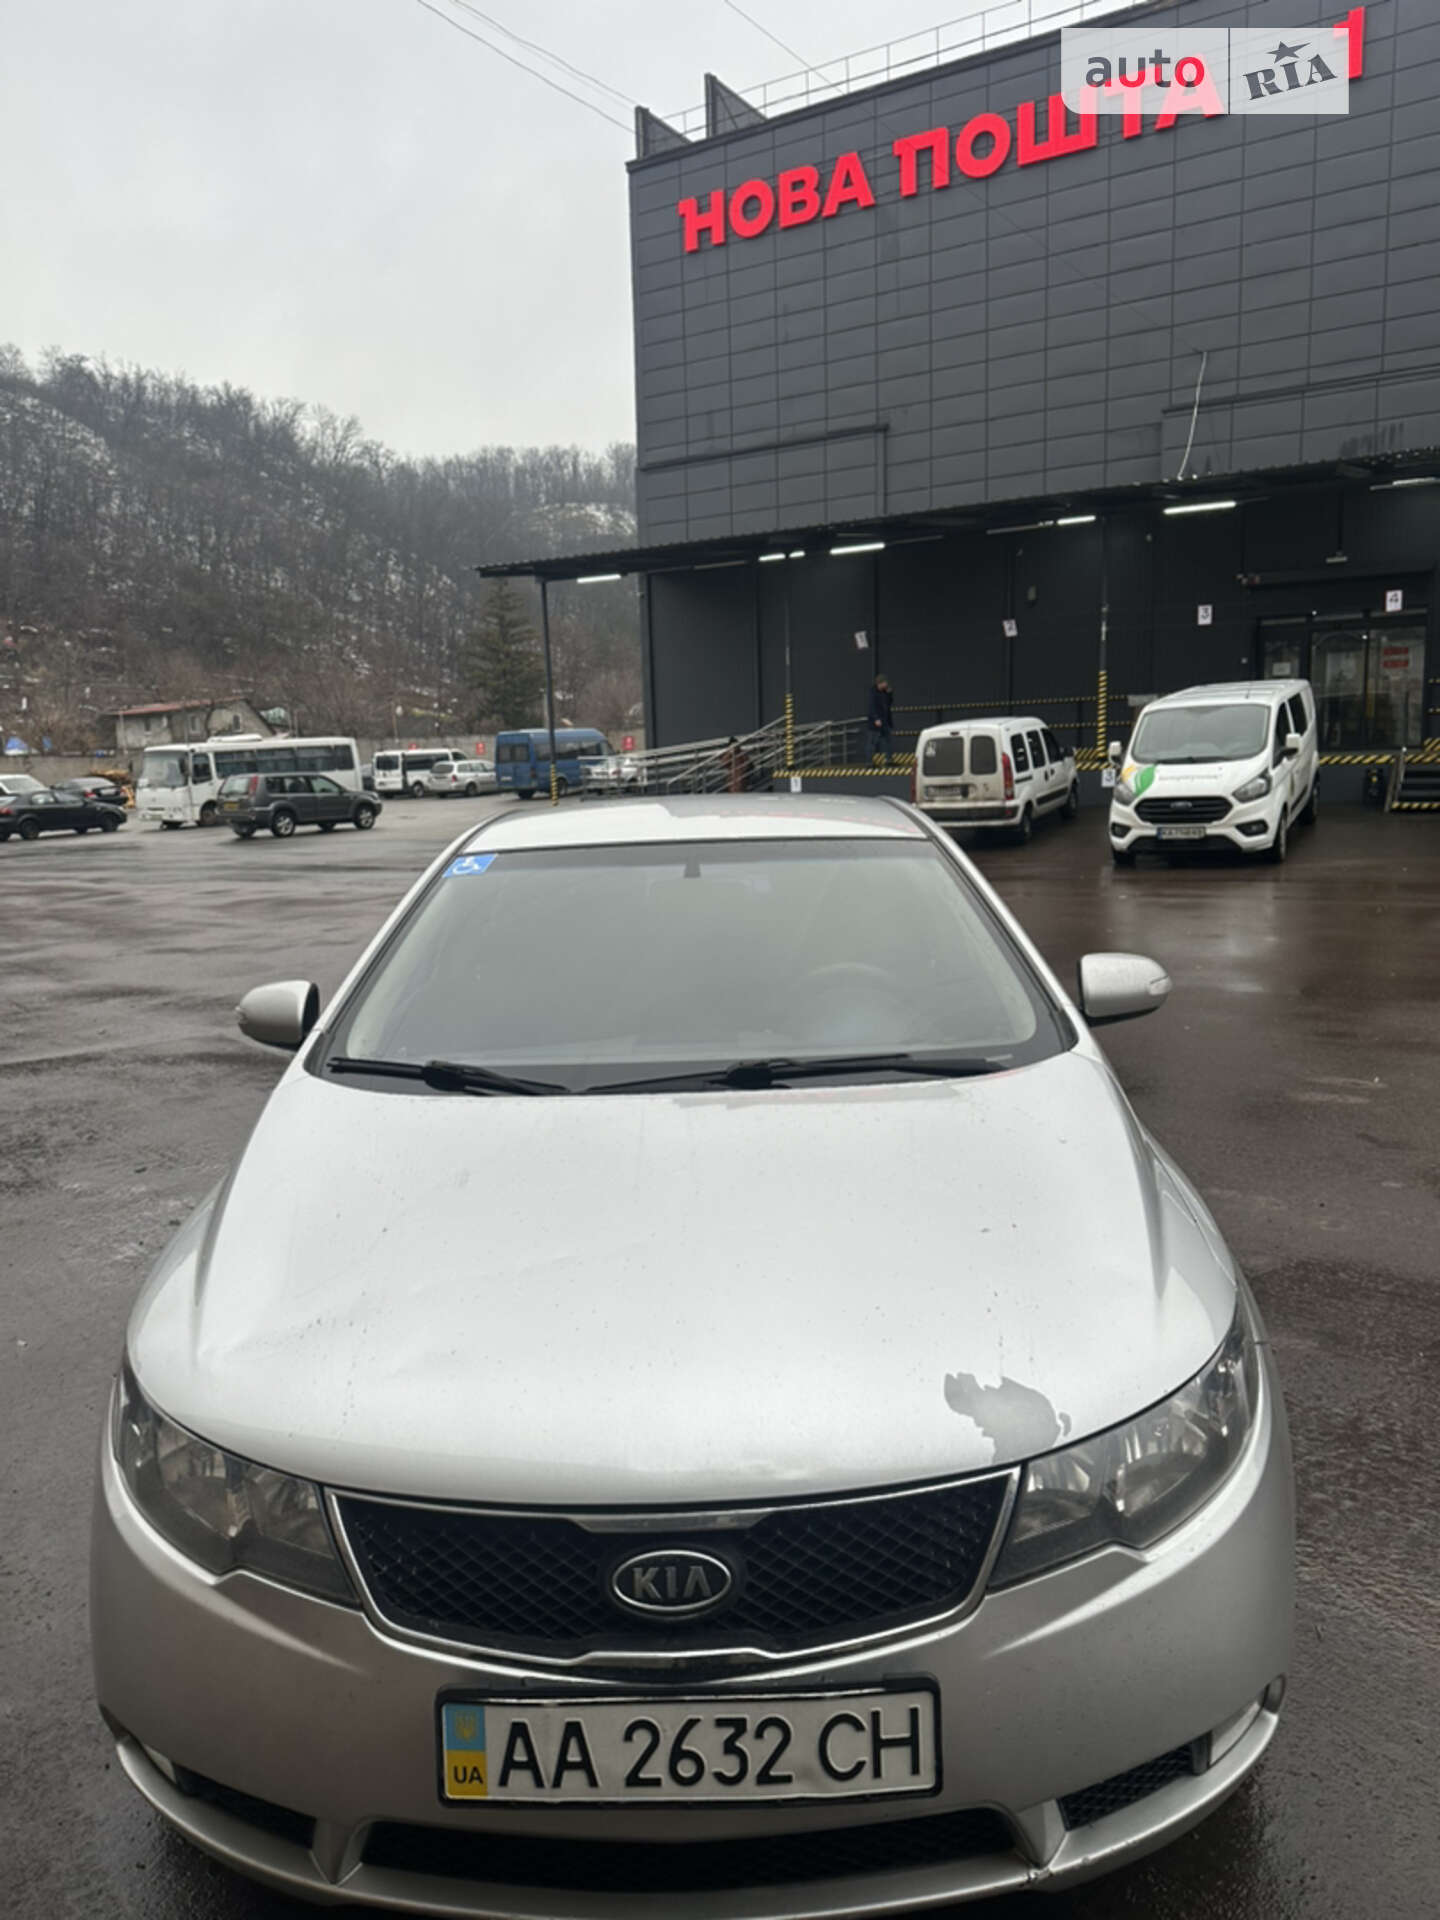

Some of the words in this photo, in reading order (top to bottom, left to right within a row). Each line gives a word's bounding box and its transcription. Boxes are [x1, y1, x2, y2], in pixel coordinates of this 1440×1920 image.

[678, 150, 876, 254] НОВА
[893, 53, 1226, 198] ПОШТА
[1333, 5, 1366, 79] 1
[632, 1566, 712, 1600] KIA
[453, 1765, 484, 1786] UA
[498, 1720, 600, 1790] AA
[623, 1715, 793, 1788] 2632
[818, 1706, 921, 1782] CH
